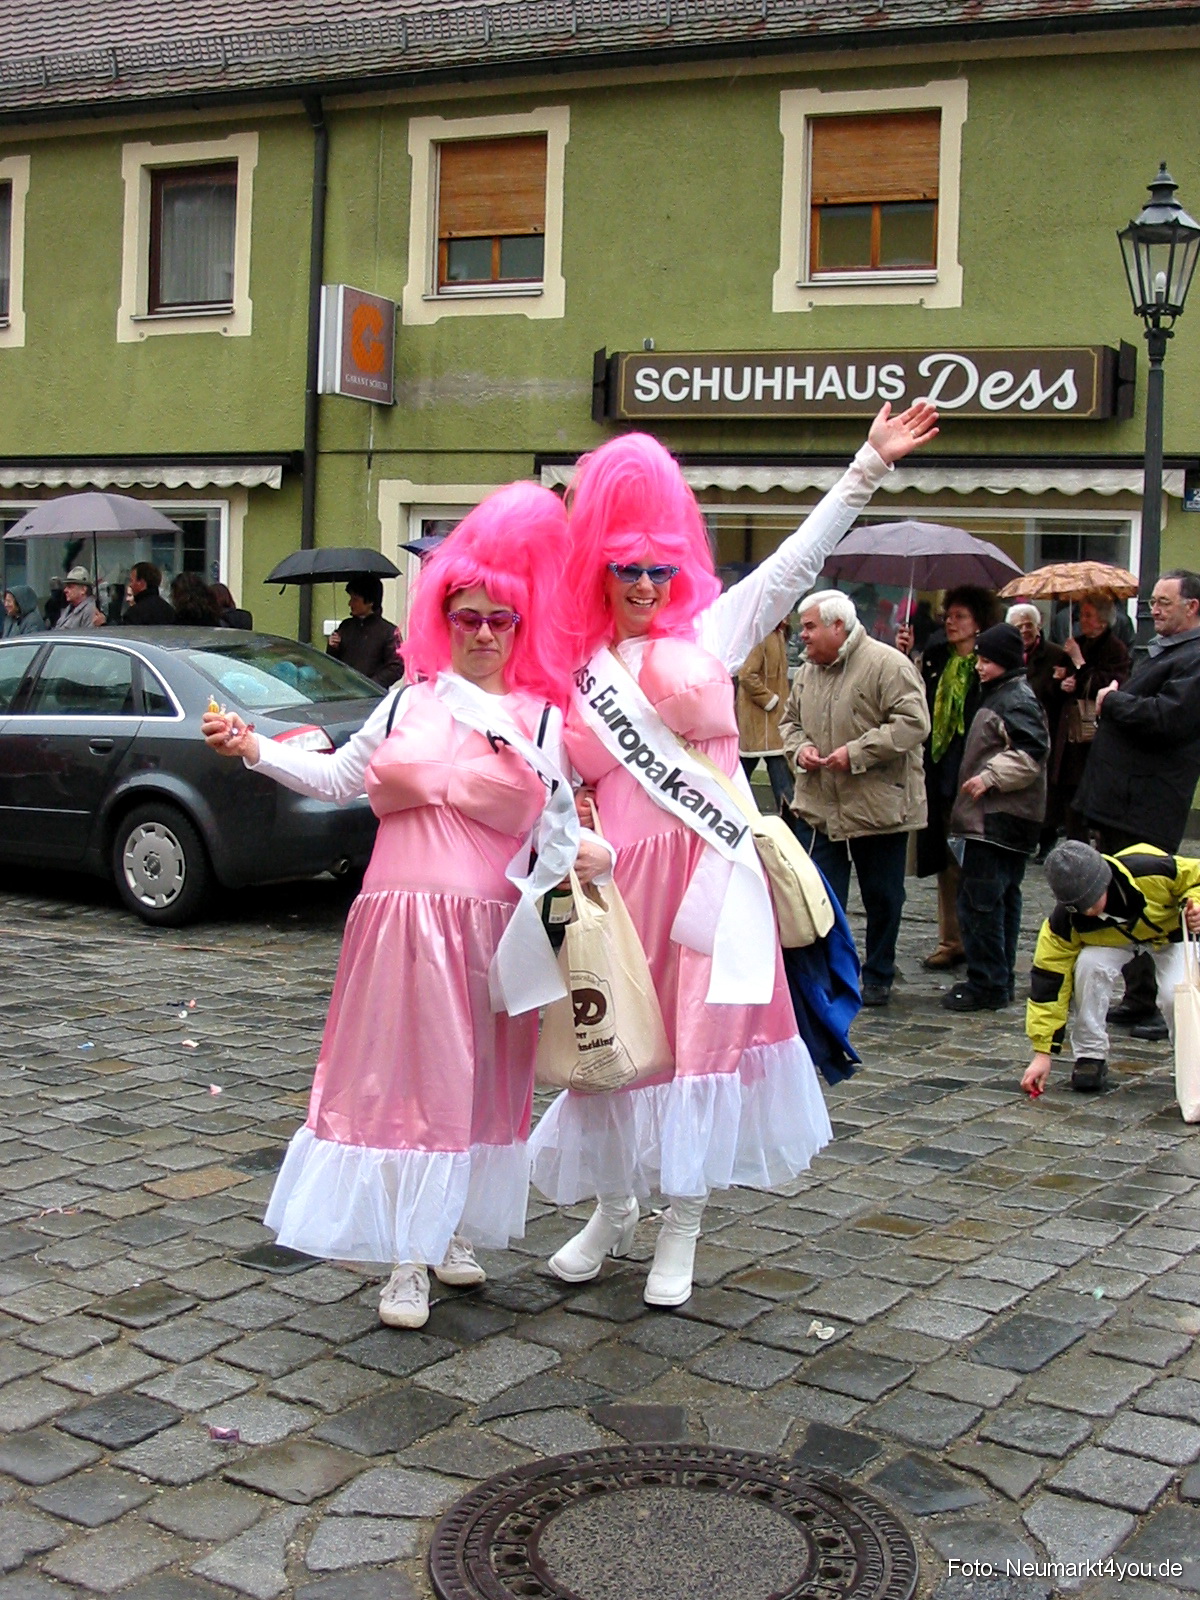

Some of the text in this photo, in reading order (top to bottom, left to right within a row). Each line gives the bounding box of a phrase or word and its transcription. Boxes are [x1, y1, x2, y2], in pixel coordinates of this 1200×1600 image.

[633, 353, 1078, 411] SCHUHHAUS Dess
[589, 684, 749, 850] Europakanal
